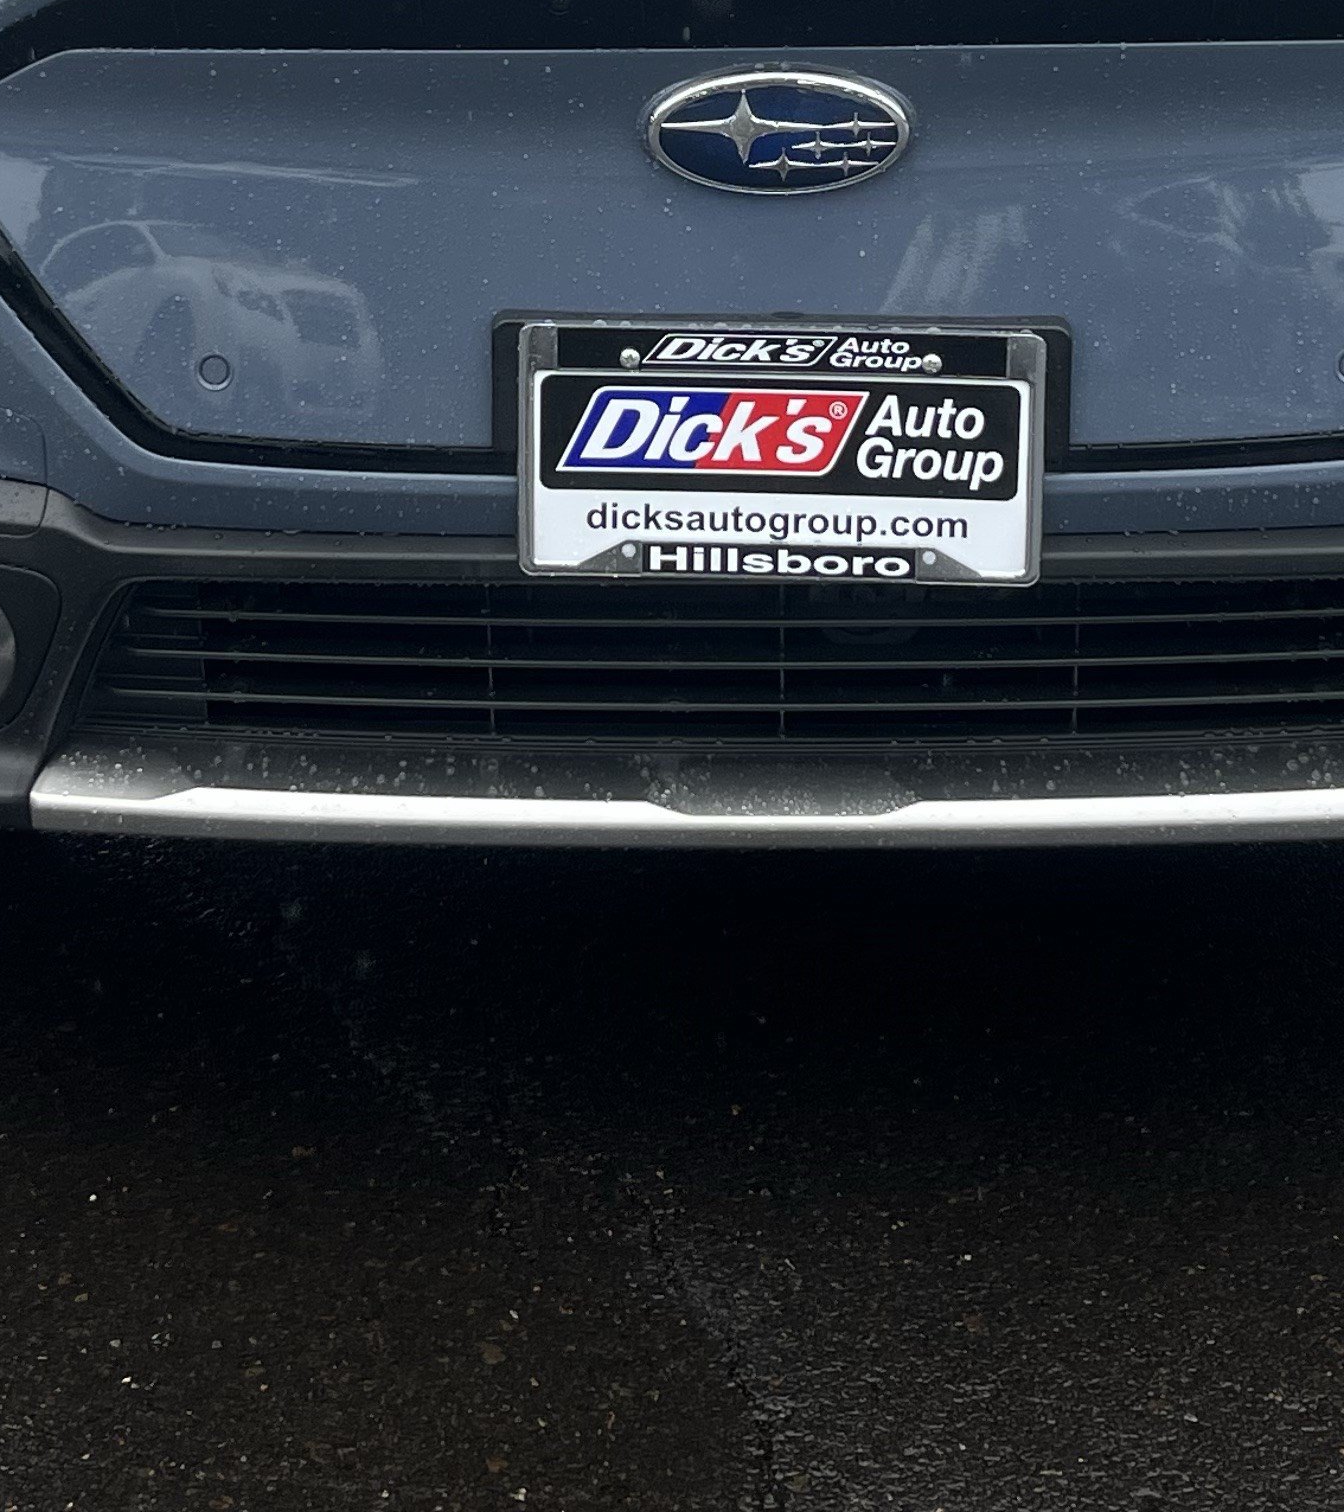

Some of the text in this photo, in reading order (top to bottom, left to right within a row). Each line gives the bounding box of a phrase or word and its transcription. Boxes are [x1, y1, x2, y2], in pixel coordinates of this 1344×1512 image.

[829, 351, 922, 372] Group
[836, 337, 910, 354] Auto
[866, 395, 986, 440] Auto
[856, 437, 1004, 490] Group
[586, 503, 969, 539] dicksautogroup.com
[648, 545, 911, 576] Hillsboro
